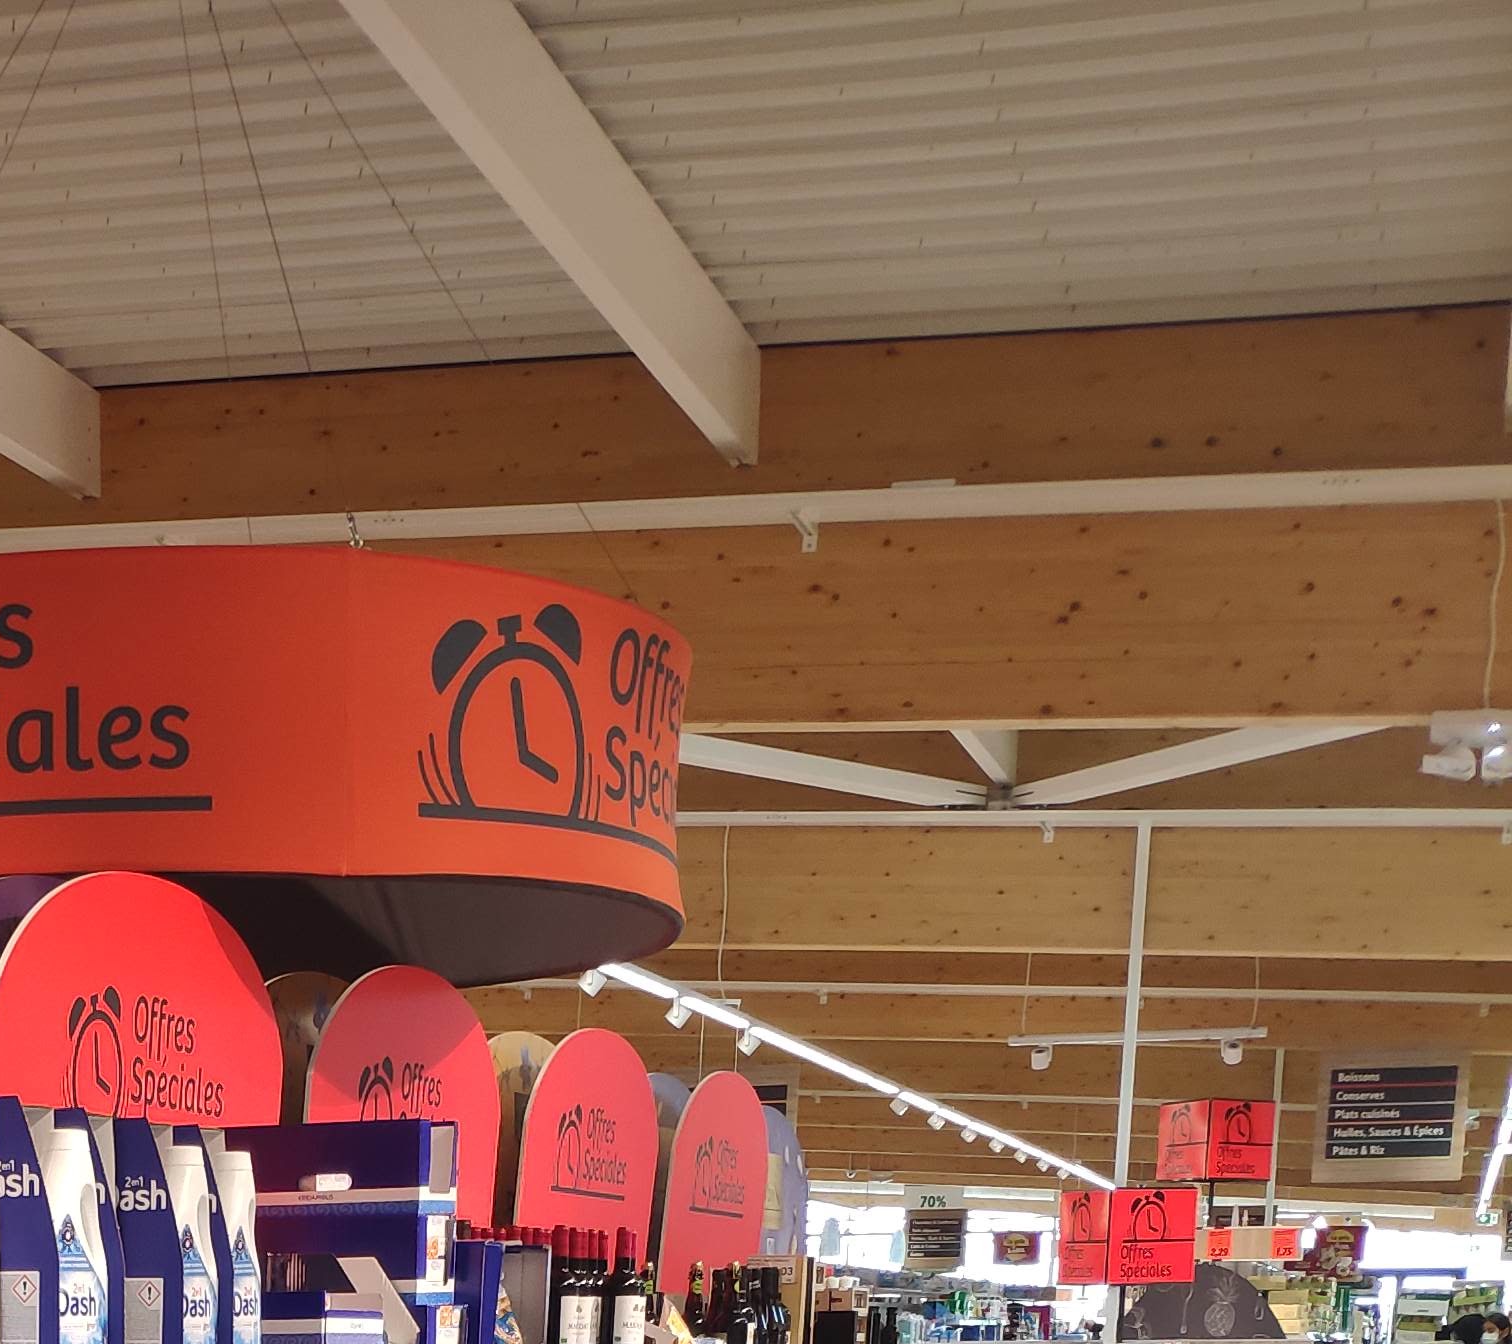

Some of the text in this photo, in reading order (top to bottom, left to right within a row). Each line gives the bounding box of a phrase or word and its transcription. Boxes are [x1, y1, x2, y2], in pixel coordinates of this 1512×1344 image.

[133, 994, 195, 1060] Offres
[130, 1055, 224, 1119] Spéciales
[401, 1062, 441, 1113] Offres
[1338, 1072, 1380, 1083] Boissons
[1336, 1090, 1385, 1102] Conserves
[1334, 1108, 1359, 1119] Plats
[587, 1107, 616, 1151] Offres
[1368, 1126, 1402, 1137] Sauces
[1403, 1126, 1411, 1137] &
[1360, 1145, 1368, 1156] &
[1369, 1145, 1385, 1156] Riz
[582, 1148, 627, 1186] Spéciales
[117, 1180, 167, 1212] ash
[920, 1195, 947, 1209] 70%
[1120, 1244, 1155, 1265] Offres
[1119, 1263, 1173, 1280] Spéciales
[59, 1287, 97, 1317] Dash
